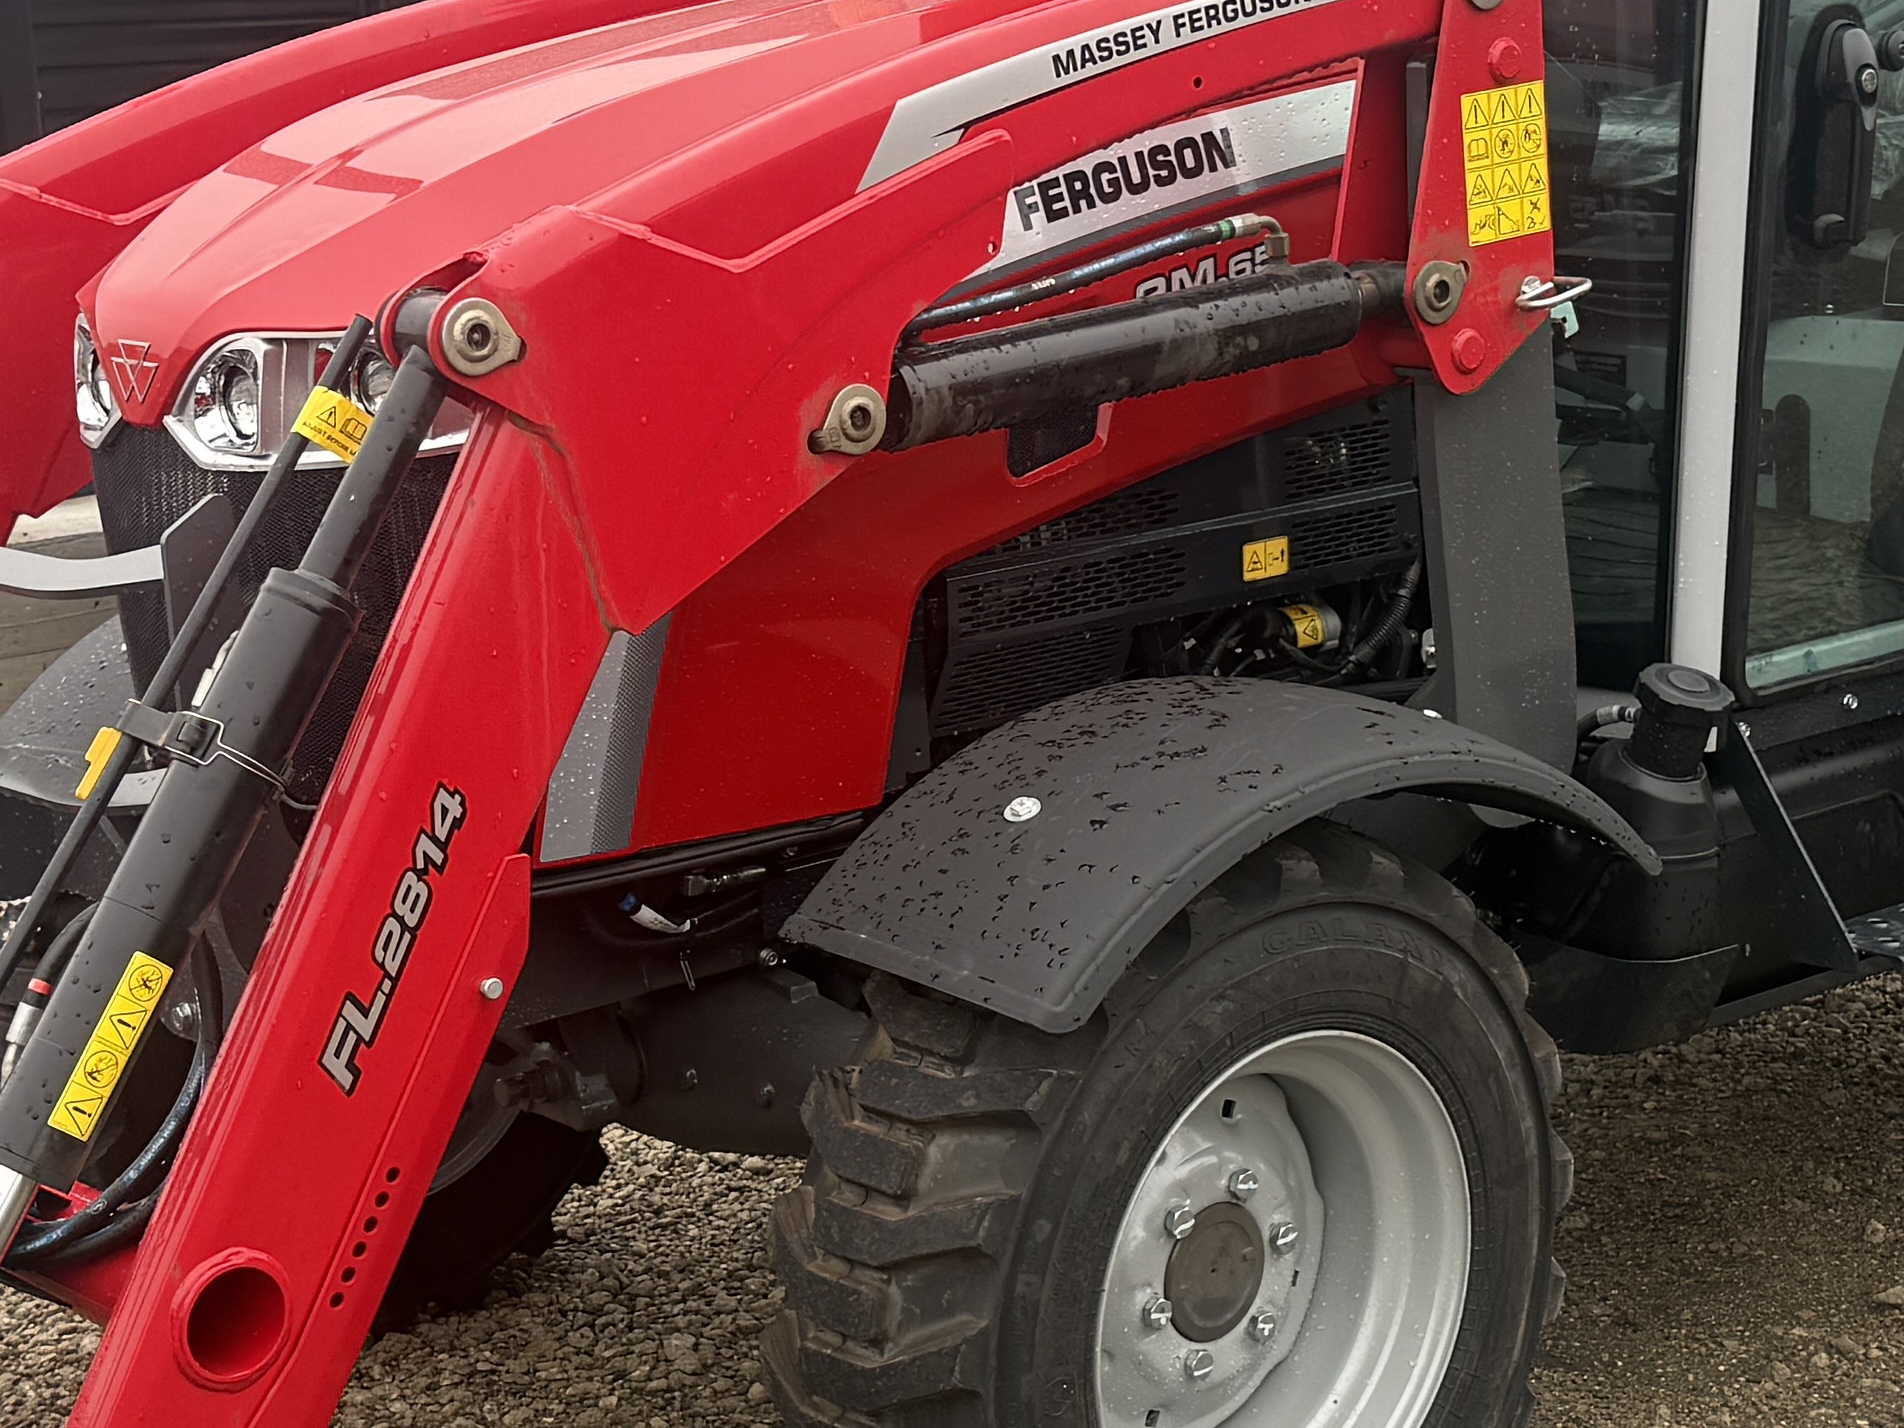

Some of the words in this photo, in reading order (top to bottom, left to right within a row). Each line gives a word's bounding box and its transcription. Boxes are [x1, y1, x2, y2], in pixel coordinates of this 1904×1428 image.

[1051, 19, 1163, 79] MASSEY
[1014, 126, 1237, 232] FERGUSON
[317, 781, 467, 1098] FL.2814
